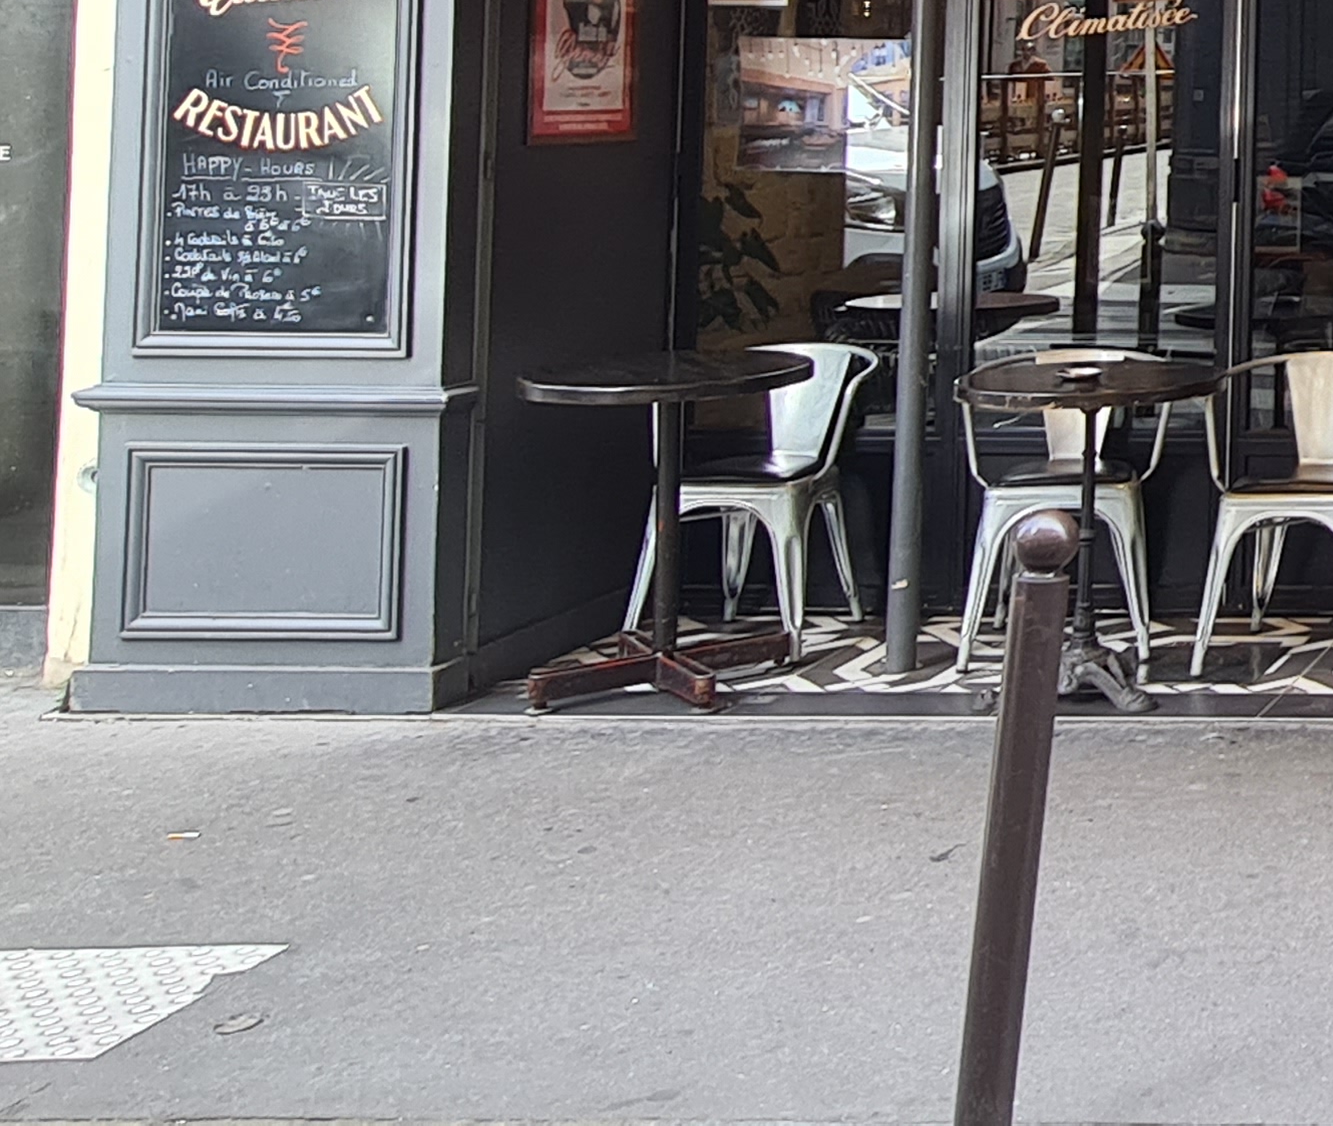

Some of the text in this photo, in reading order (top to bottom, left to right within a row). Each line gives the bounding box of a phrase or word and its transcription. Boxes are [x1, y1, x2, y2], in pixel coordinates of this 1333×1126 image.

[204, 70, 233, 88] Air
[172, 85, 385, 153] RESTAURANT
[182, 153, 243, 181] HAPPY
[260, 158, 316, 175] HOURS
